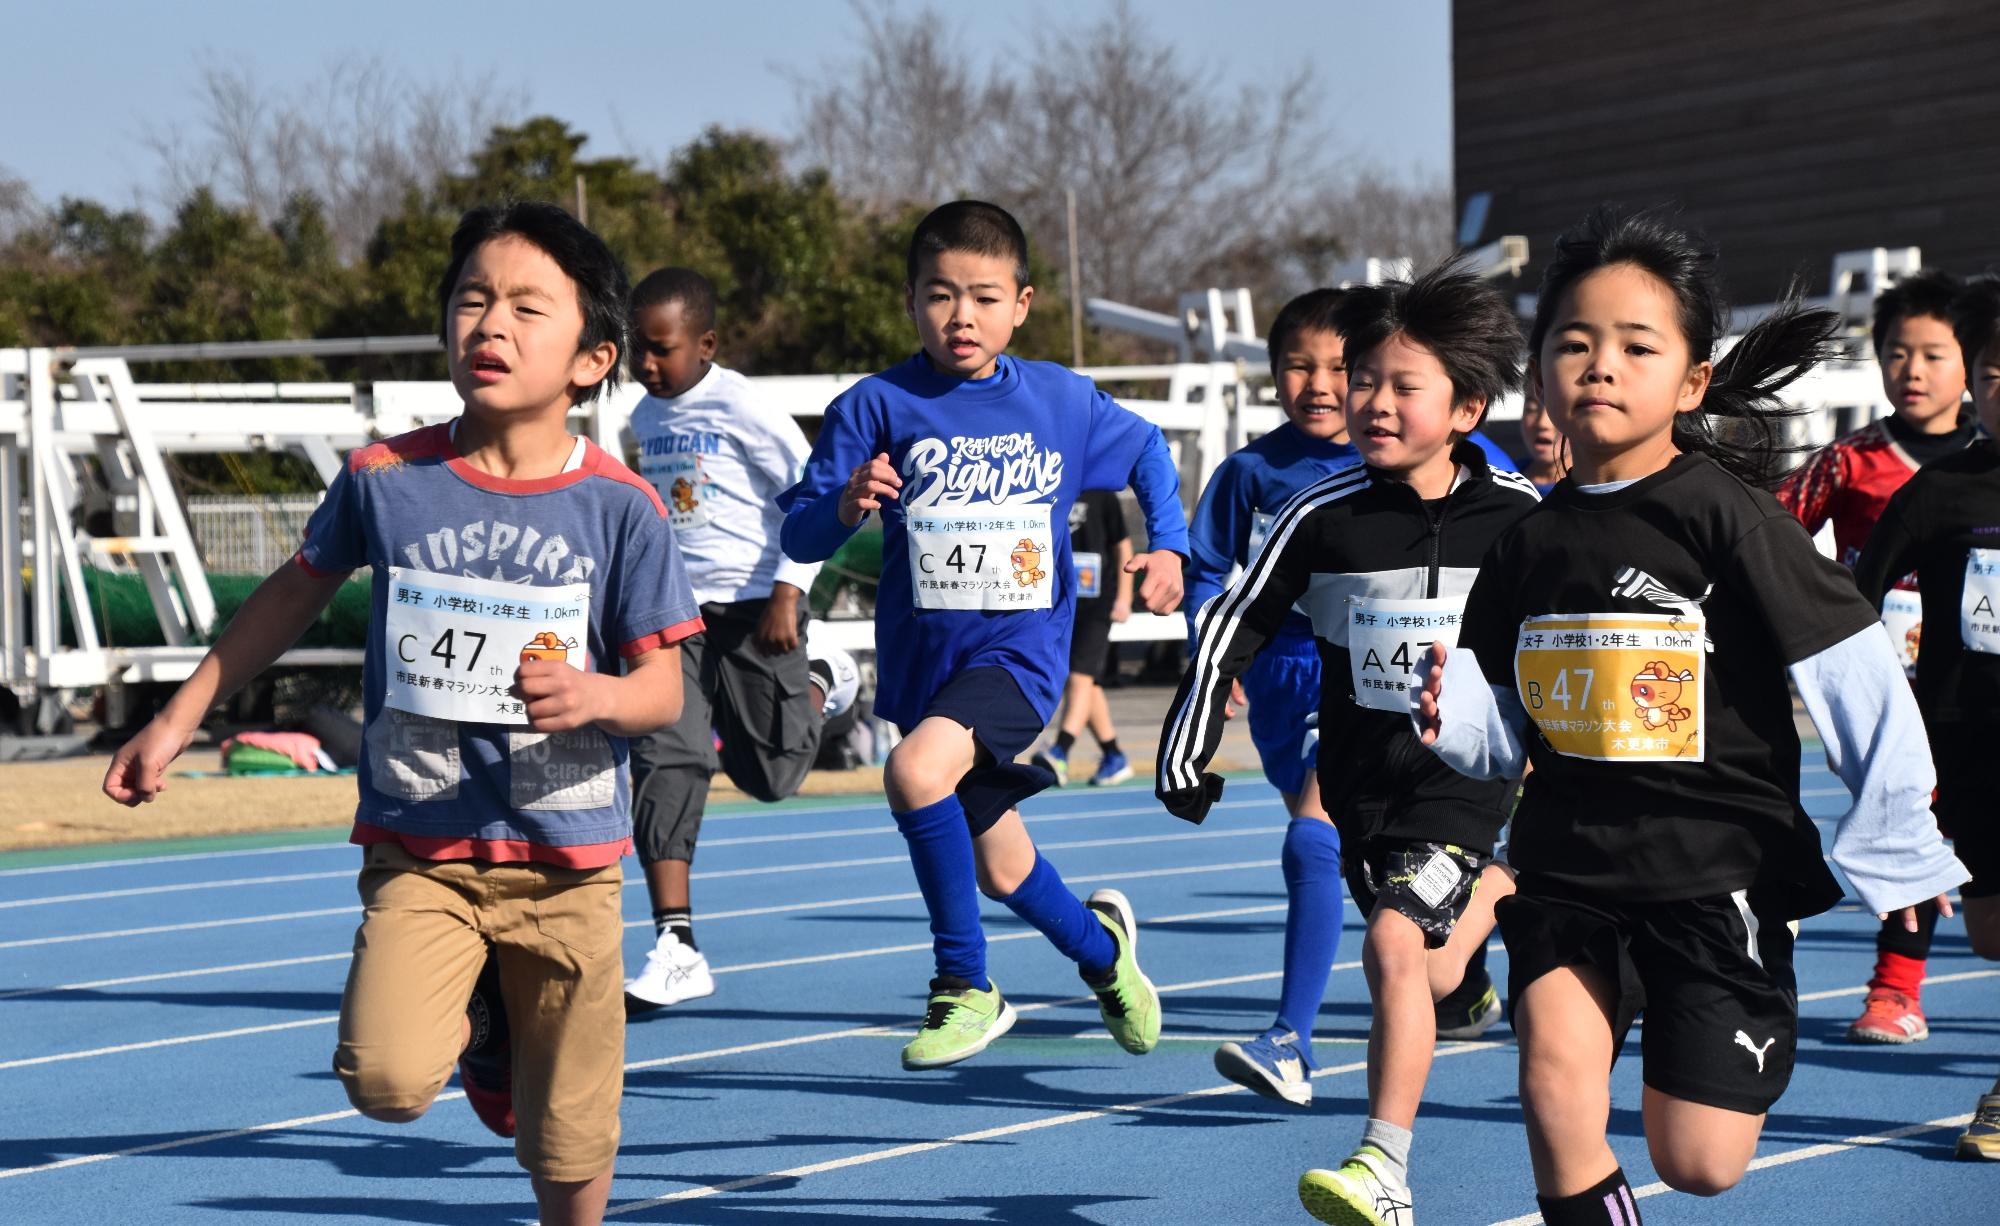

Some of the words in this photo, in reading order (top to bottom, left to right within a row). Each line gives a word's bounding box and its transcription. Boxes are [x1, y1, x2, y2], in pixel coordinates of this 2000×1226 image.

[951, 433, 1036, 460] KANEDA
[913, 520, 935, 531] 男子
[1023, 520, 1046, 529] 1.0km
[919, 553, 935, 574] C
[945, 544, 987, 574] 47
[1973, 563, 1994, 574] 男子
[919, 580, 1011, 590] 市民新春マラソン大会
[396, 588, 423, 603] 男子
[544, 606, 580, 620] 1.0km
[1972, 595, 1995, 618] A
[1355, 612, 1378, 626] 男子
[398, 634, 418, 663] C
[431, 628, 487, 672] 47
[490, 665, 503, 677] th
[1523, 634, 1544, 648] 女子
[1655, 636, 1692, 648] 1.0km
[1362, 648, 1386, 674] A
[1528, 681, 1543, 710] B
[1551, 668, 1594, 711] 47
[1602, 699, 1615, 710] th
[1611, 737, 1670, 751] 木更津市
